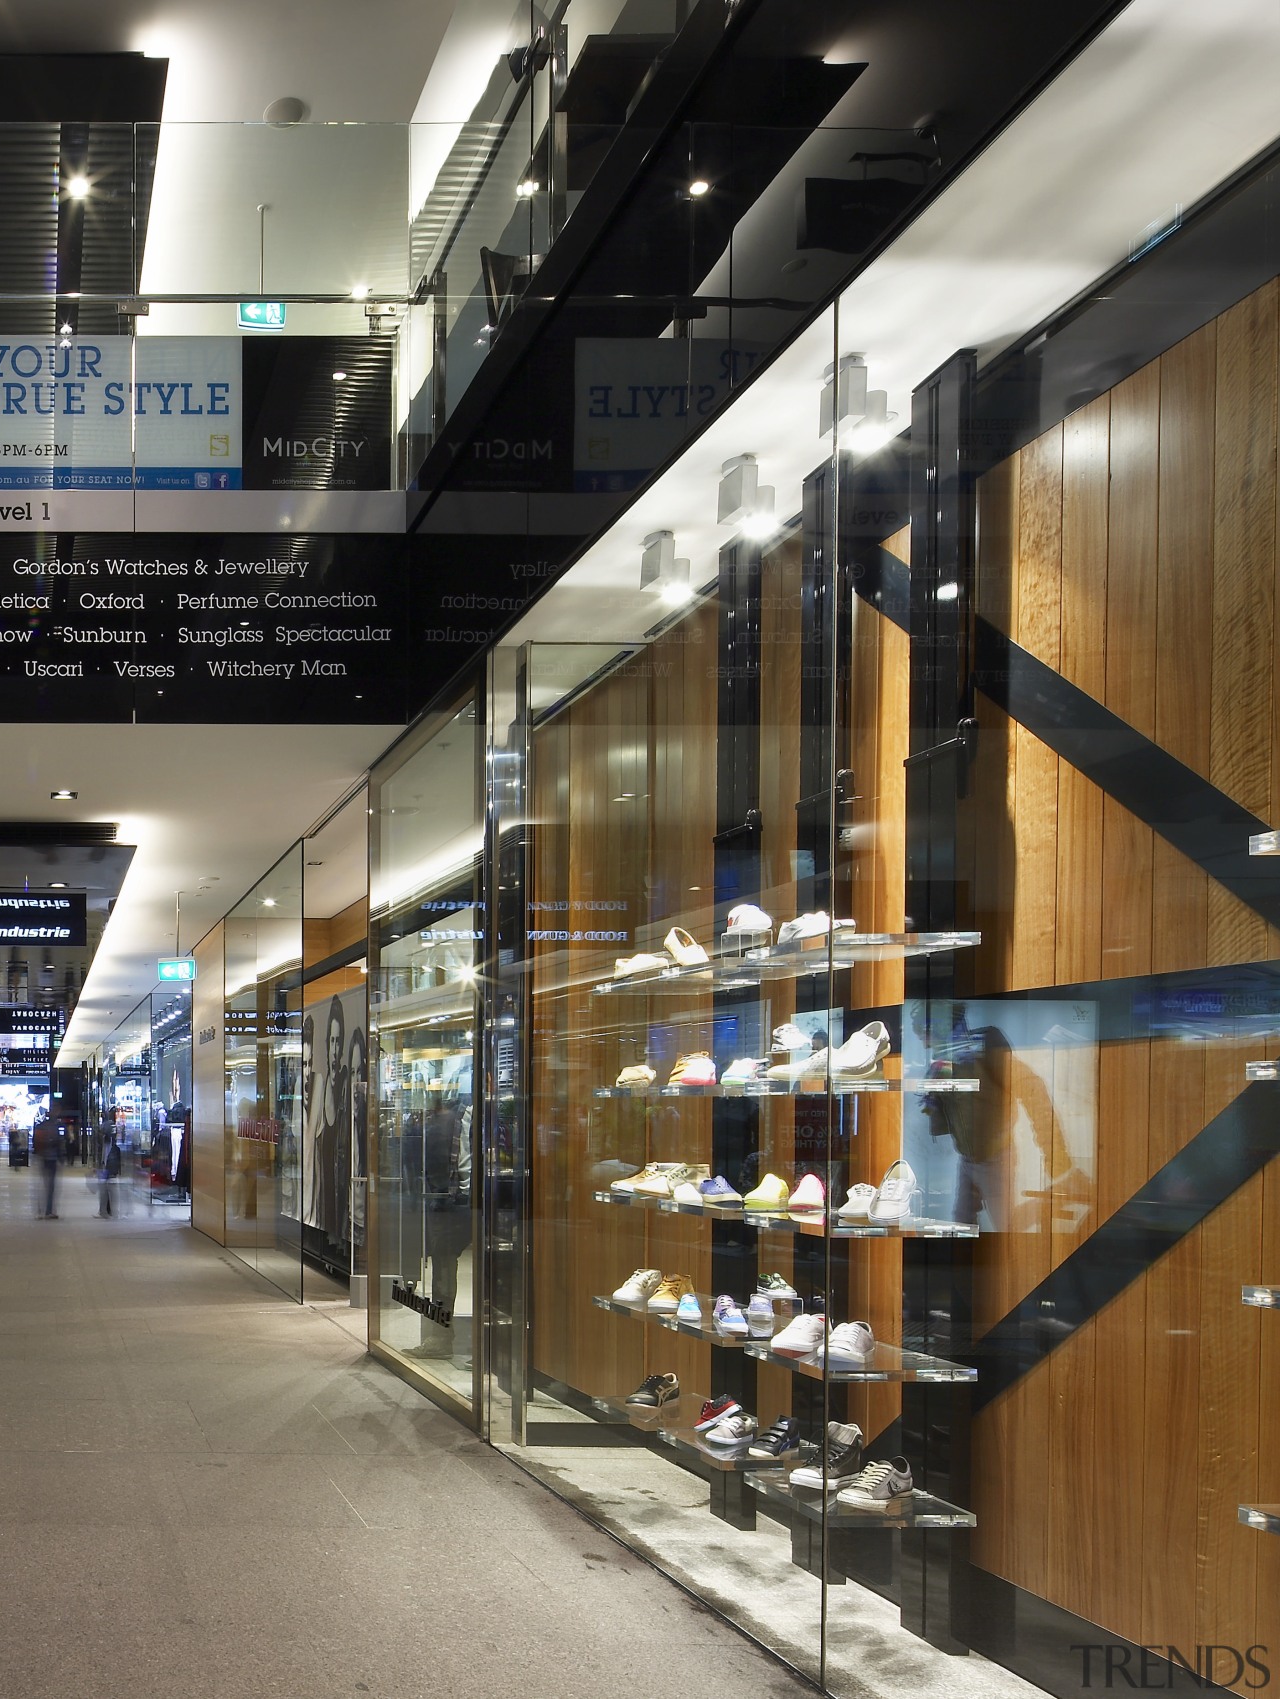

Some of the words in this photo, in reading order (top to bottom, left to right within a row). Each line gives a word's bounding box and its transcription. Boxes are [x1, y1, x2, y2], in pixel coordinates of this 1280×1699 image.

[104, 382, 230, 415] STYLE
[33, 475, 54, 484] FOR
[57, 475, 86, 484] YOUR
[88, 475, 113, 484] SEAT
[116, 475, 145, 485] NOW!
[156, 477, 171, 485] Visit
[42, 502, 51, 521] 1
[12, 558, 100, 576] Gordon's
[105, 558, 189, 576] Watches
[194, 558, 209, 576] &
[214, 558, 310, 578] Jewellery
[79, 592, 146, 610] Oxford
[177, 593, 259, 610] Perfume
[264, 591, 378, 608] Connection
[62, 626, 148, 643] Sunburn
[178, 627, 264, 647] Sunglass
[275, 625, 393, 646] Spectacular
[24, 660, 84, 677] Uscari
[113, 661, 175, 678] Verses
[206, 660, 295, 679] Witchery
[301, 660, 348, 676] Man
[391, 1279, 452, 1328] industrie
